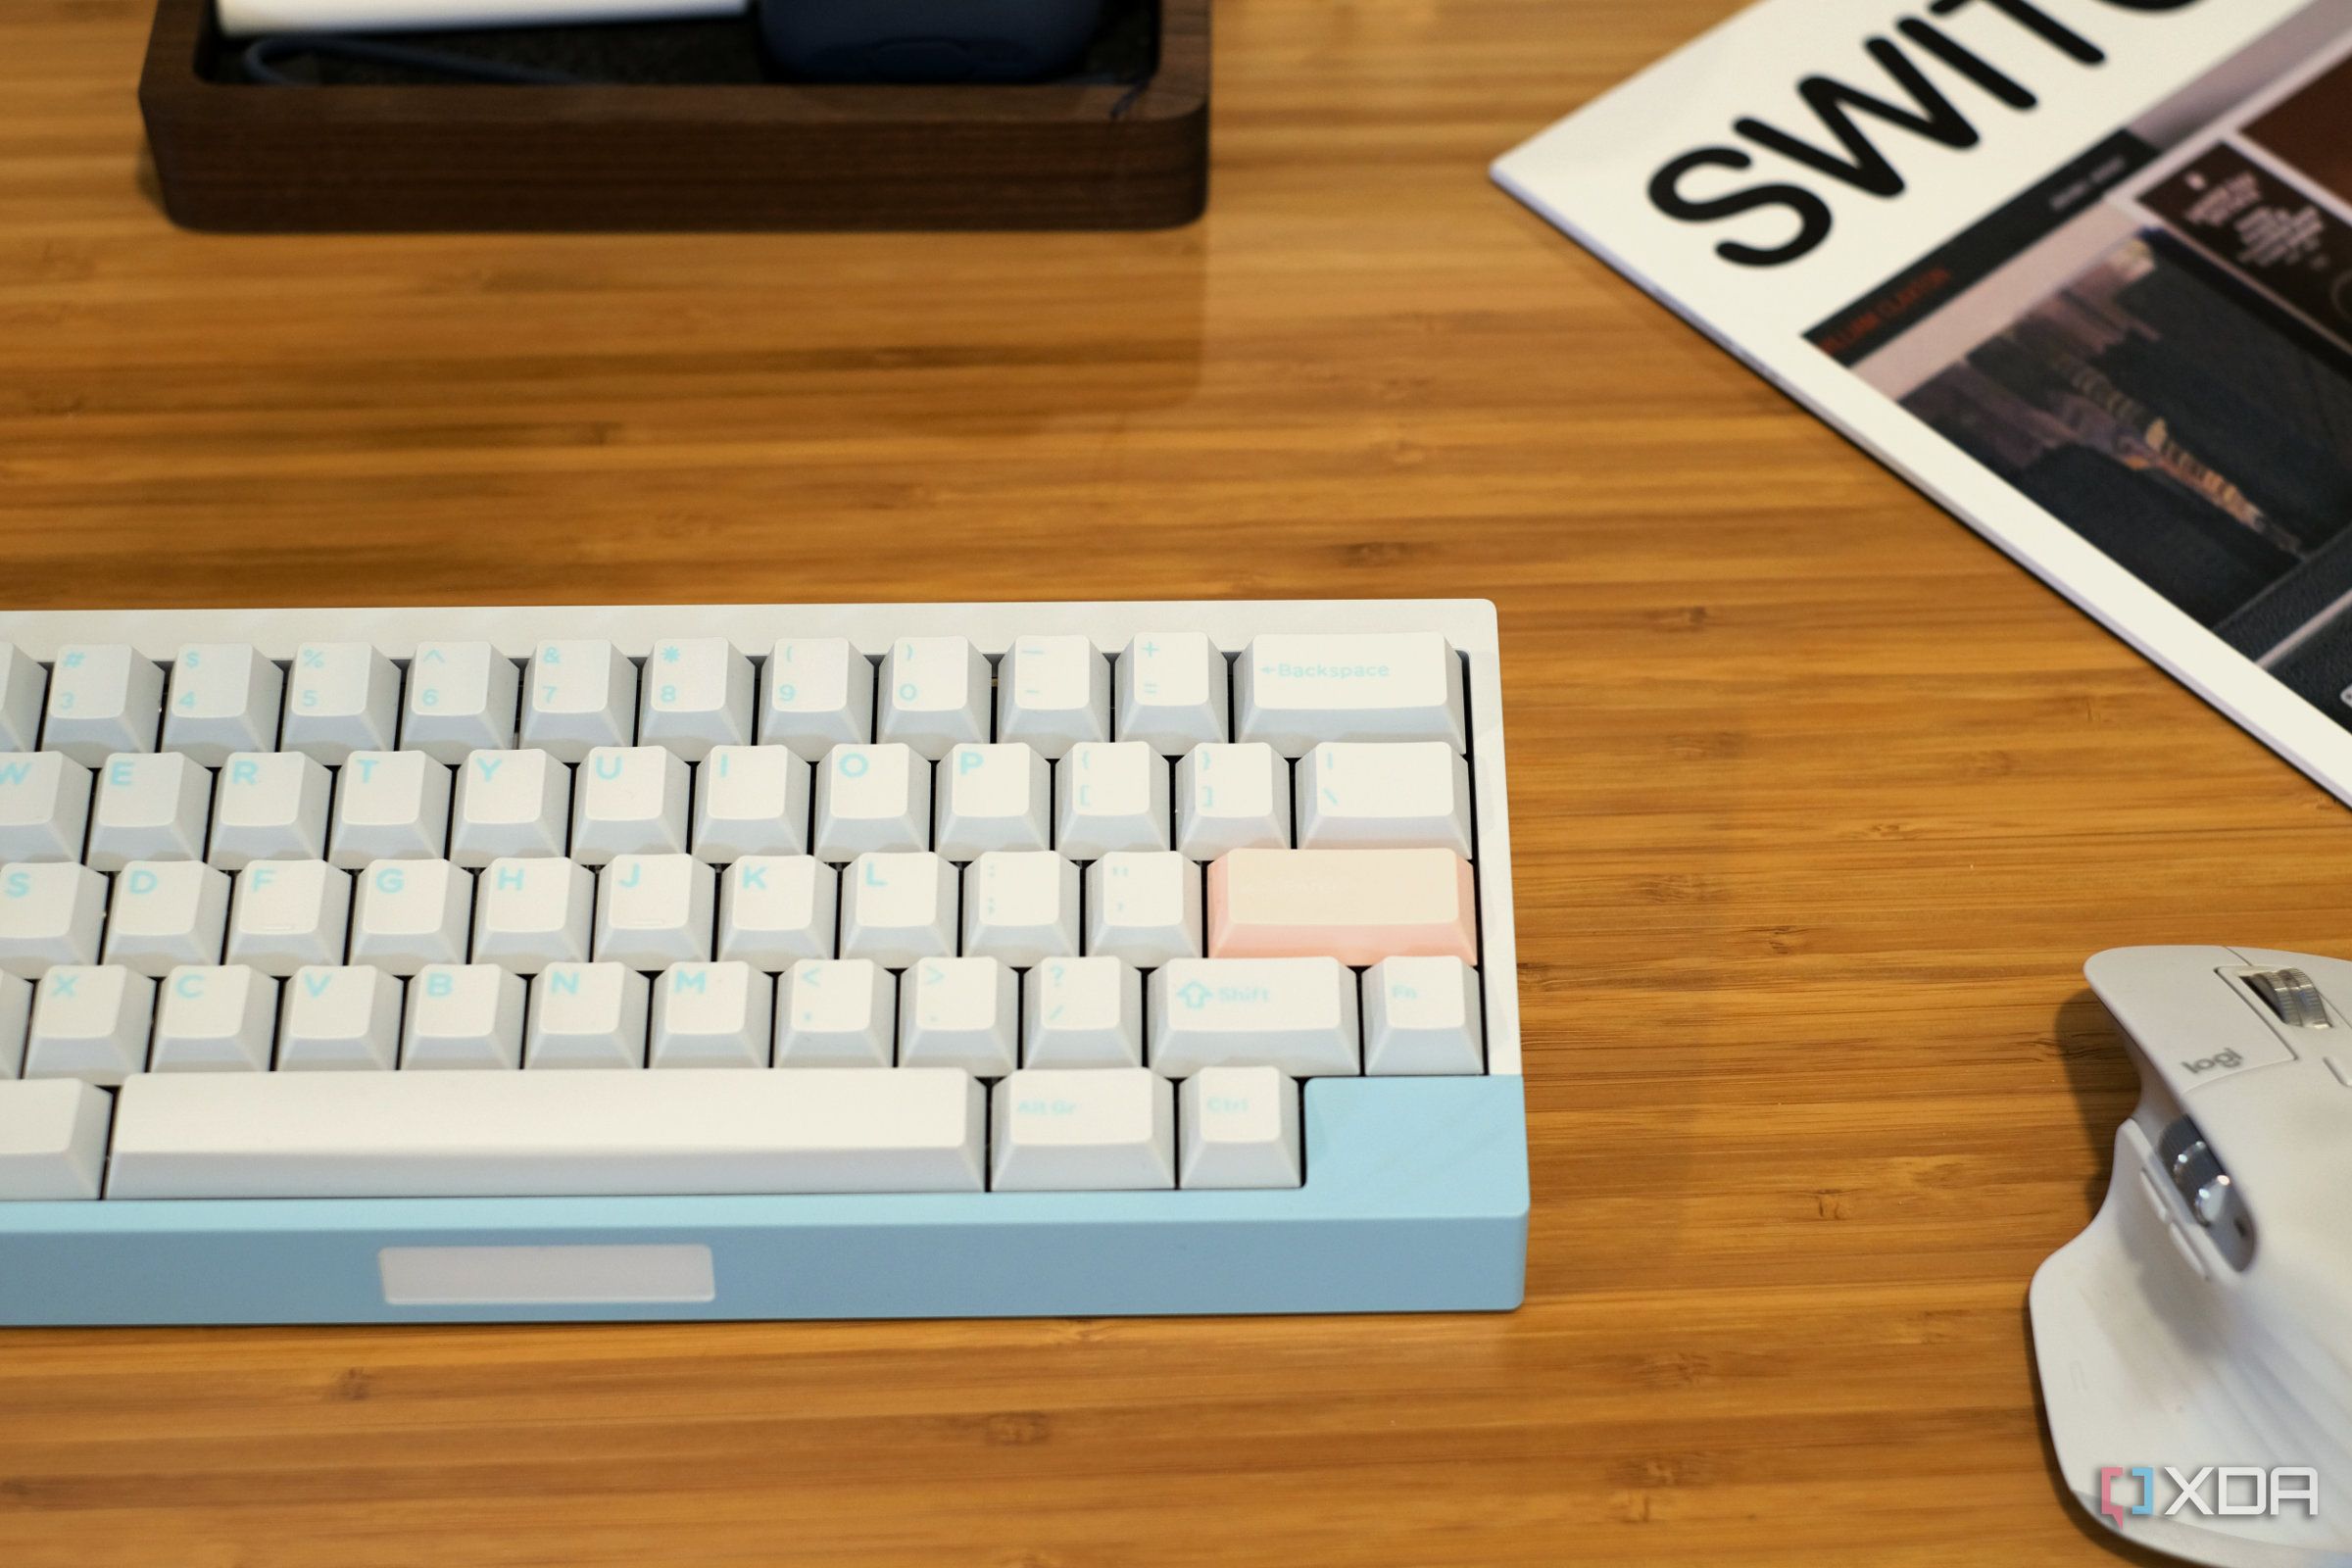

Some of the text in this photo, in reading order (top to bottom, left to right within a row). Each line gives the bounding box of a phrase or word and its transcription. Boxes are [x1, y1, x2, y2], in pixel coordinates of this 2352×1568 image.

[1648, 0, 2197, 267] SWIT
[62, 651, 85, 668] #
[303, 648, 325, 669] %
[422, 649, 445, 663] ^
[543, 645, 561, 665] &
[785, 644, 794, 662] (
[906, 643, 914, 662] )
[1141, 640, 1160, 658] +
[185, 651, 200, 669] $
[1279, 662, 1390, 680] Backspace
[302, 689, 318, 708] 5
[420, 687, 439, 707] 6
[542, 684, 558, 705] 7
[660, 684, 676, 703] 8
[778, 683, 796, 702] 9
[1144, 682, 1158, 696] =
[60, 690, 75, 711] 3
[178, 690, 197, 710] 4
[357, 758, 380, 784] T
[476, 758, 503, 783] Y
[595, 755, 622, 781] U
[718, 754, 730, 778] I
[838, 752, 869, 778] O
[960, 752, 985, 774] P
[1080, 752, 1090, 770] {
[1202, 753, 1211, 771] }
[0, 761, 32, 786] W
[111, 761, 133, 786] E
[232, 759, 258, 785] R
[1079, 786, 1091, 806] [
[1203, 786, 1213, 807] ]
[1323, 788, 1339, 806] \
[6, 871, 30, 899] S
[128, 870, 158, 895] D
[253, 869, 275, 892] F
[375, 868, 405, 894] G
[498, 868, 524, 892] H
[619, 864, 642, 889] J
[742, 865, 767, 889] K
[865, 863, 888, 888] L
[52, 974, 78, 997] X
[304, 974, 331, 998] V
[426, 973, 454, 998] B
[550, 972, 579, 995] N
[674, 970, 706, 994] M
[801, 967, 821, 987] <
[925, 966, 946, 986] >
[1050, 965, 1065, 986] ?
[176, 974, 204, 999] C
[1217, 985, 1270, 1003] Shift
[1049, 1004, 1064, 1021] /
[2180, 1047, 2242, 1074] logi
[1016, 1100, 1049, 1115] Alt
[1206, 1097, 1249, 1114] Ctrl
